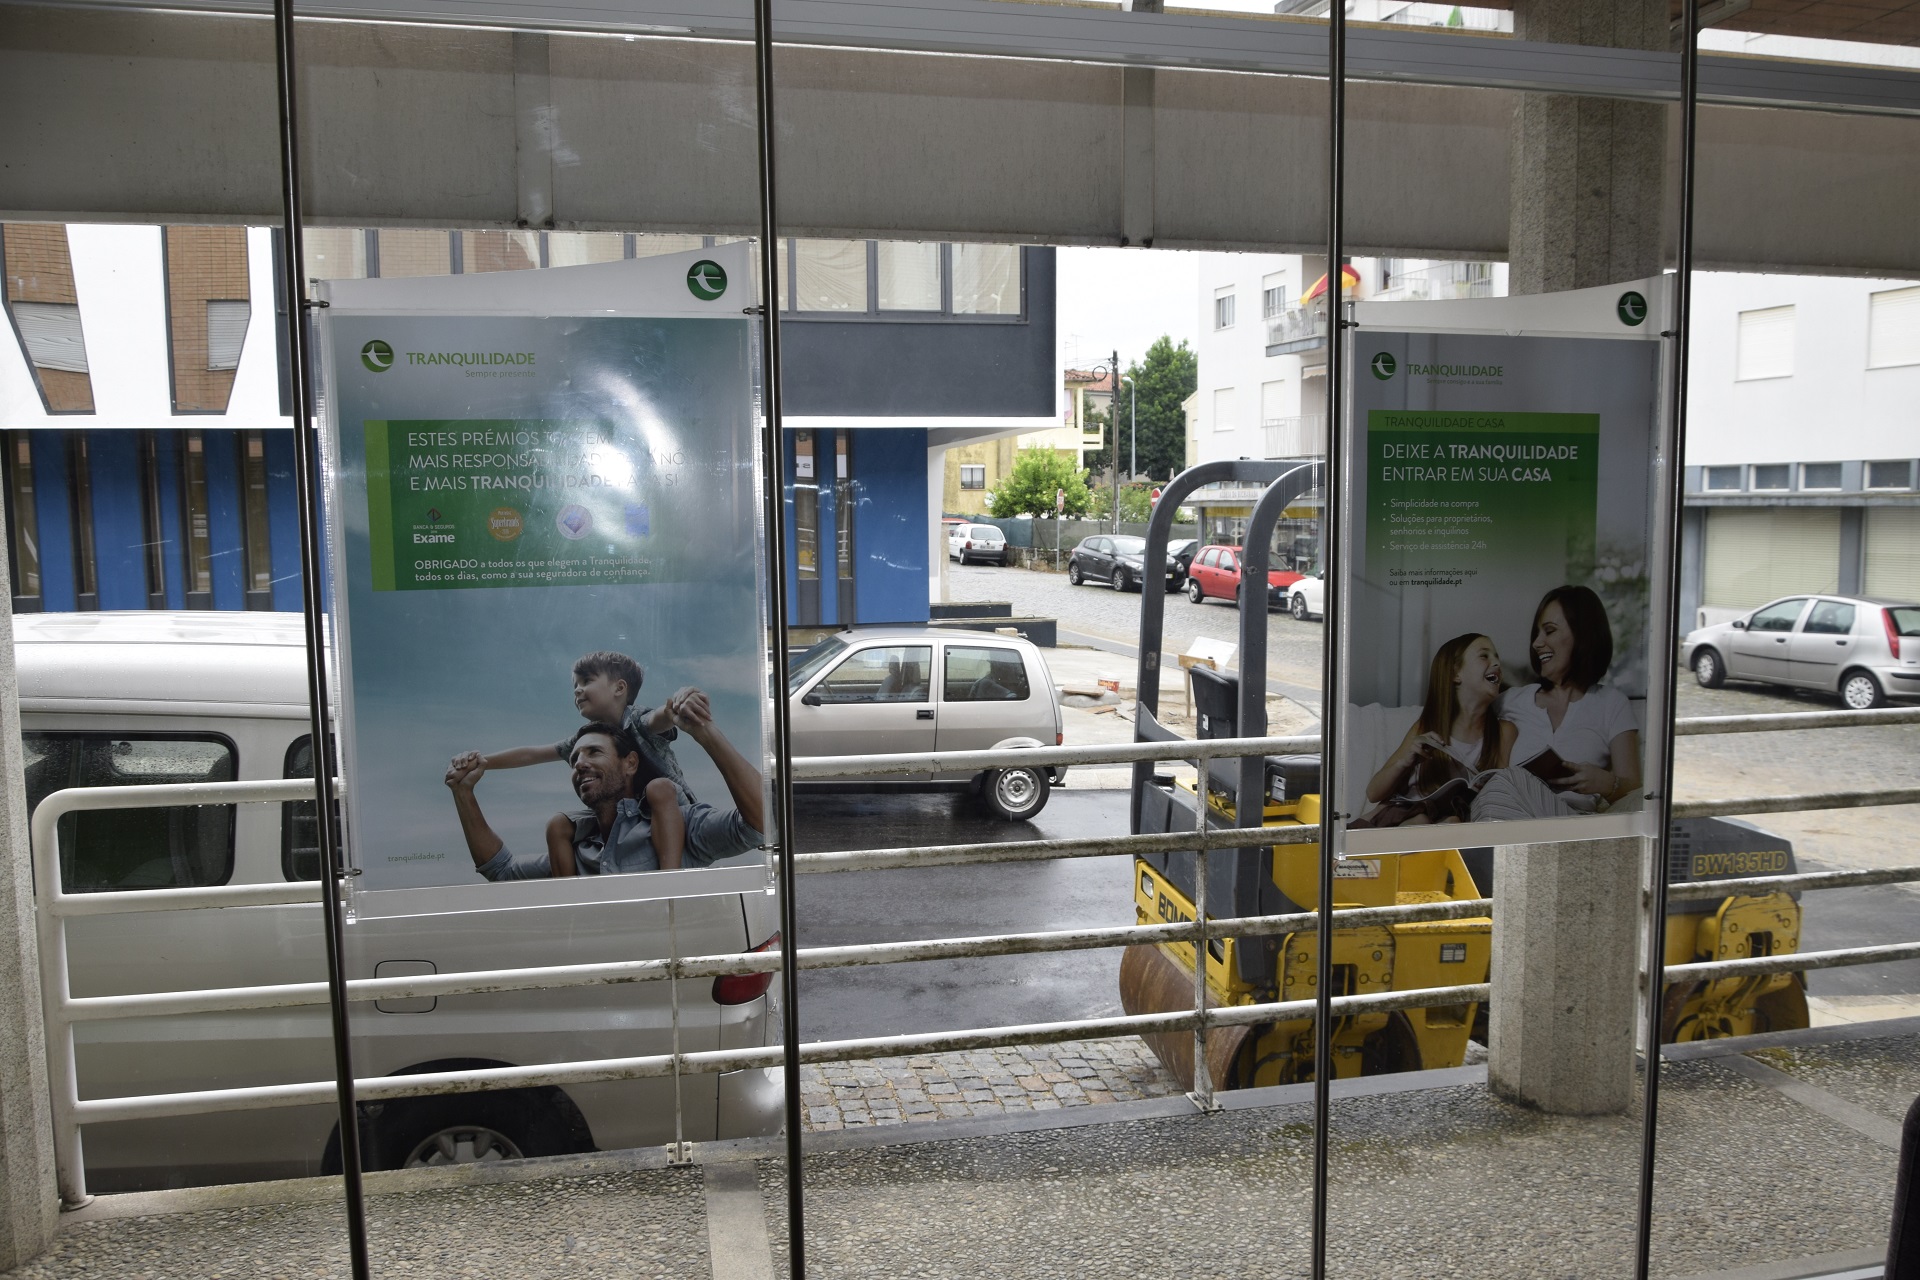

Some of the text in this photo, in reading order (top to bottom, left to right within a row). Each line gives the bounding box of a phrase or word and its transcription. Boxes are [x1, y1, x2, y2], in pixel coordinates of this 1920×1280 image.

[406, 352, 536, 367] TRANQUILIDADE
[465, 370, 536, 379] Sempre presente
[1406, 363, 1504, 377] TRANQUILIDADE
[1384, 416, 1505, 429] TRANQUILIDADE CASA
[408, 432, 458, 447] ESTES
[462, 428, 539, 446] PRÉMIOS
[1383, 443, 1578, 462] DEIXE A TRANQUILIDADE
[409, 454, 450, 469] MAIS
[1383, 466, 1552, 482] ENTRAR EM SUA CASA
[410, 476, 421, 491] E
[425, 476, 468, 490] MAIS
[665, 473, 679, 487] SI
[1390, 498, 1439, 510] Simplicidade
[1452, 500, 1479, 510] compra
[1390, 513, 1425, 525] Soluções
[1426, 516, 1442, 525] para
[1390, 526, 1426, 535] senhorios
[1434, 525, 1469, 537] inquilinos
[413, 533, 456, 544] Exame
[1390, 540, 1487, 552] Serviço de assistência 24h
[414, 559, 478, 570] OBRIGADO
[488, 559, 513, 568] todos
[528, 560, 545, 570] que
[547, 557, 580, 569] elegem
[415, 572, 441, 582] todos
[457, 571, 479, 581] dias,
[481, 572, 507, 580] como
[518, 571, 534, 579] sua
[536, 569, 587, 580] seguradora
[590, 567, 601, 577] de
[603, 566, 651, 578] confiança.
[1389, 567, 1478, 578] Saiba mais informações aqui
[1411, 577, 1462, 587] tranquilidade.pt
[388, 852, 445, 864] tranquilidade.pt
[1693, 851, 1788, 875] BW135HD
